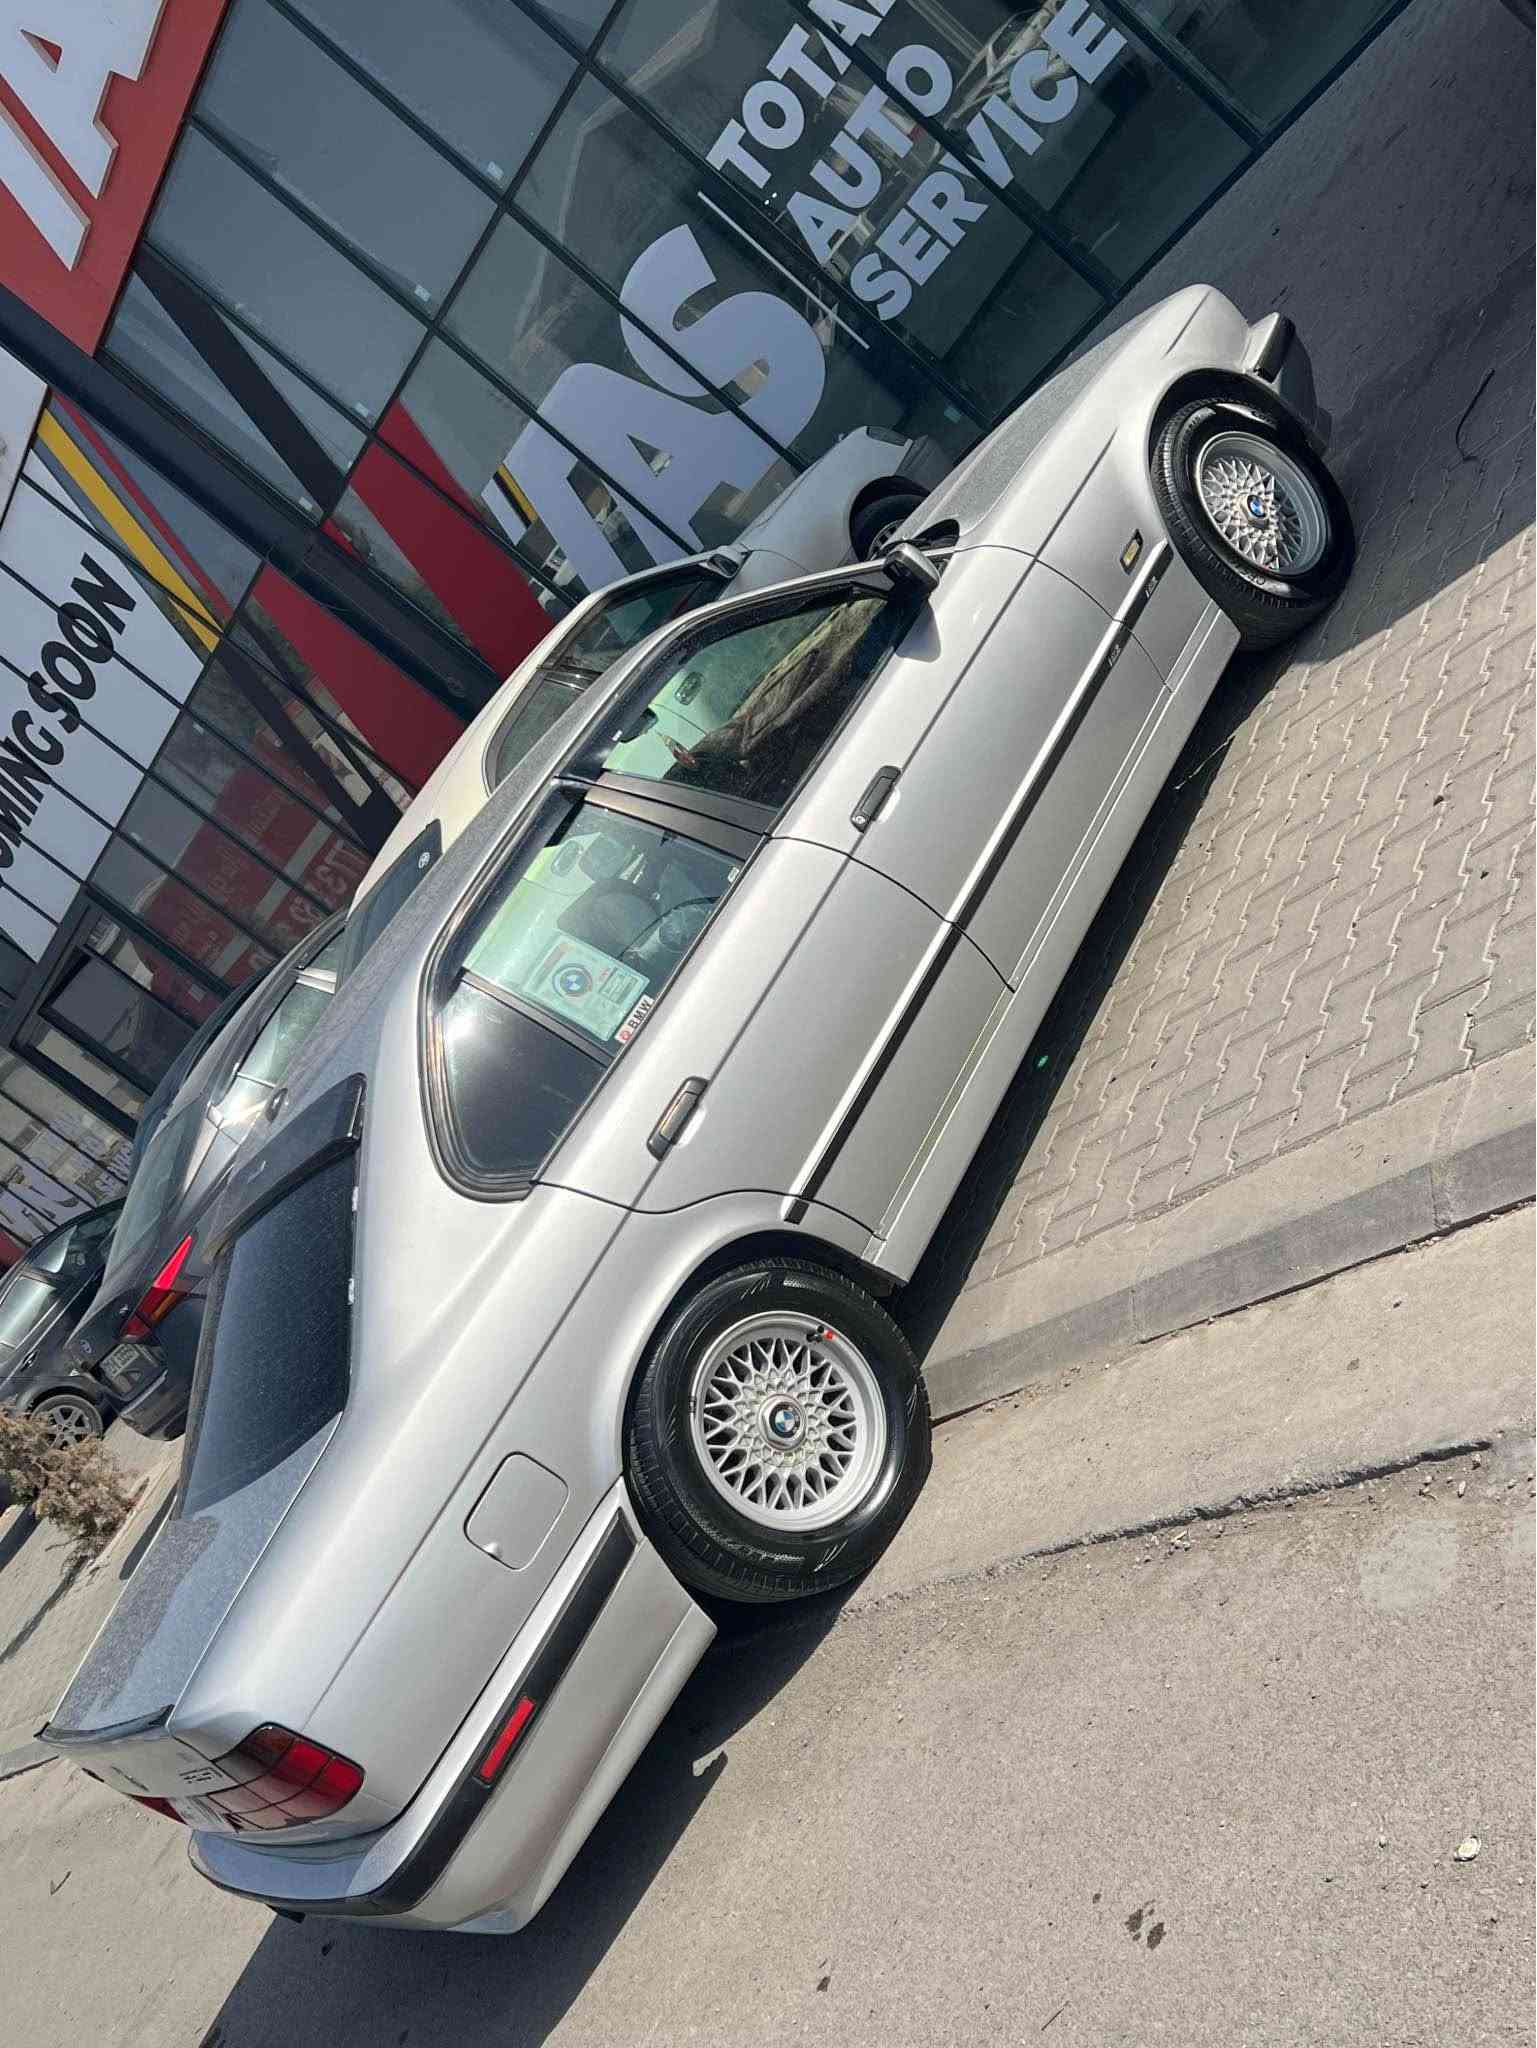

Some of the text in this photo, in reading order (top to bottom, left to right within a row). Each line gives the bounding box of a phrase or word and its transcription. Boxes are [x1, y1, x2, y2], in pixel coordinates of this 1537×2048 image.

[786, 44, 953, 267] AUTO
[850, 0, 1128, 321] SERVICE
[27, 552, 137, 734] SOON
[627, 999, 653, 1029] BMW
